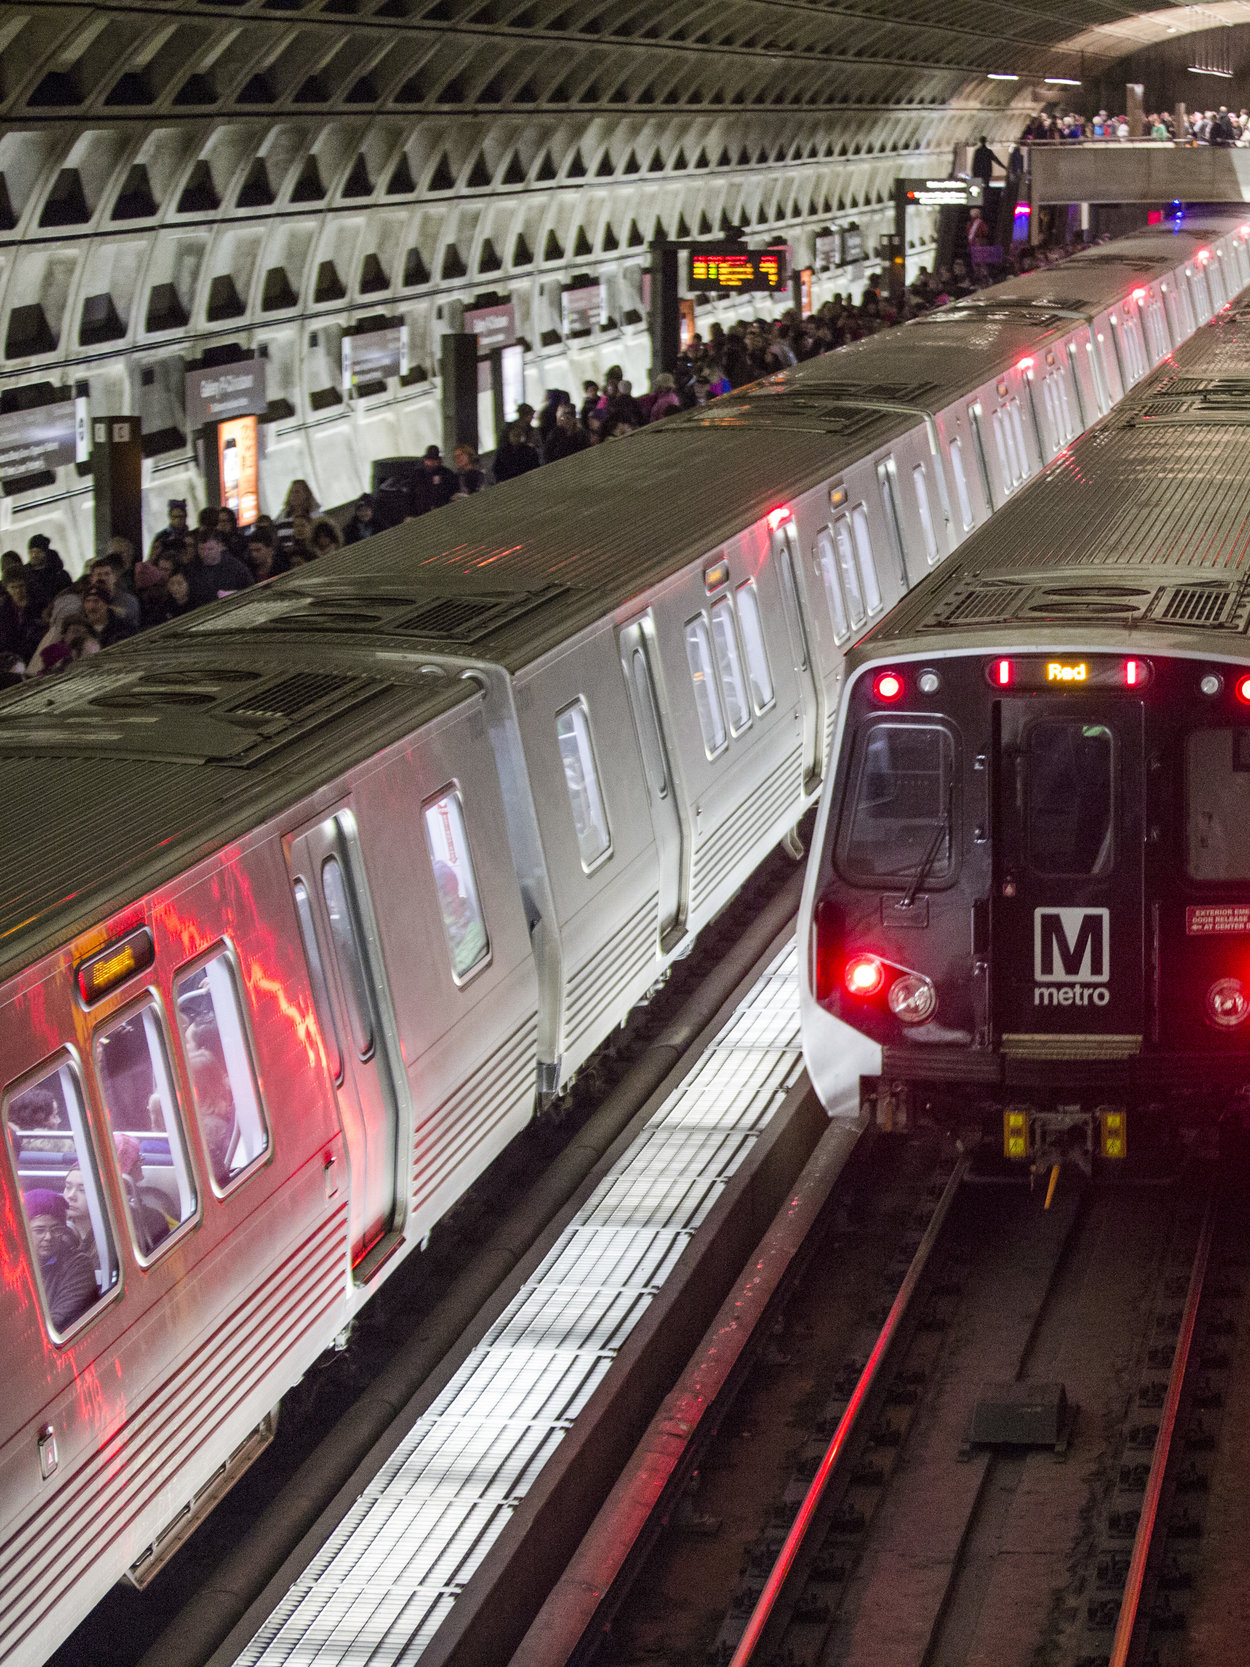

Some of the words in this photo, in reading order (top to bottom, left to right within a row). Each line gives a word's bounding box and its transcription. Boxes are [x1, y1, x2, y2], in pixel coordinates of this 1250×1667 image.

[1047, 663, 1086, 681] Red
[1192, 916, 1213, 924] DOOR
[1215, 915, 1248, 923] RELEASE
[1196, 909, 1233, 917] EXTERIOR
[1203, 923, 1214, 931] AT
[1041, 913, 1104, 976] M
[1034, 984, 1110, 1006] metro
